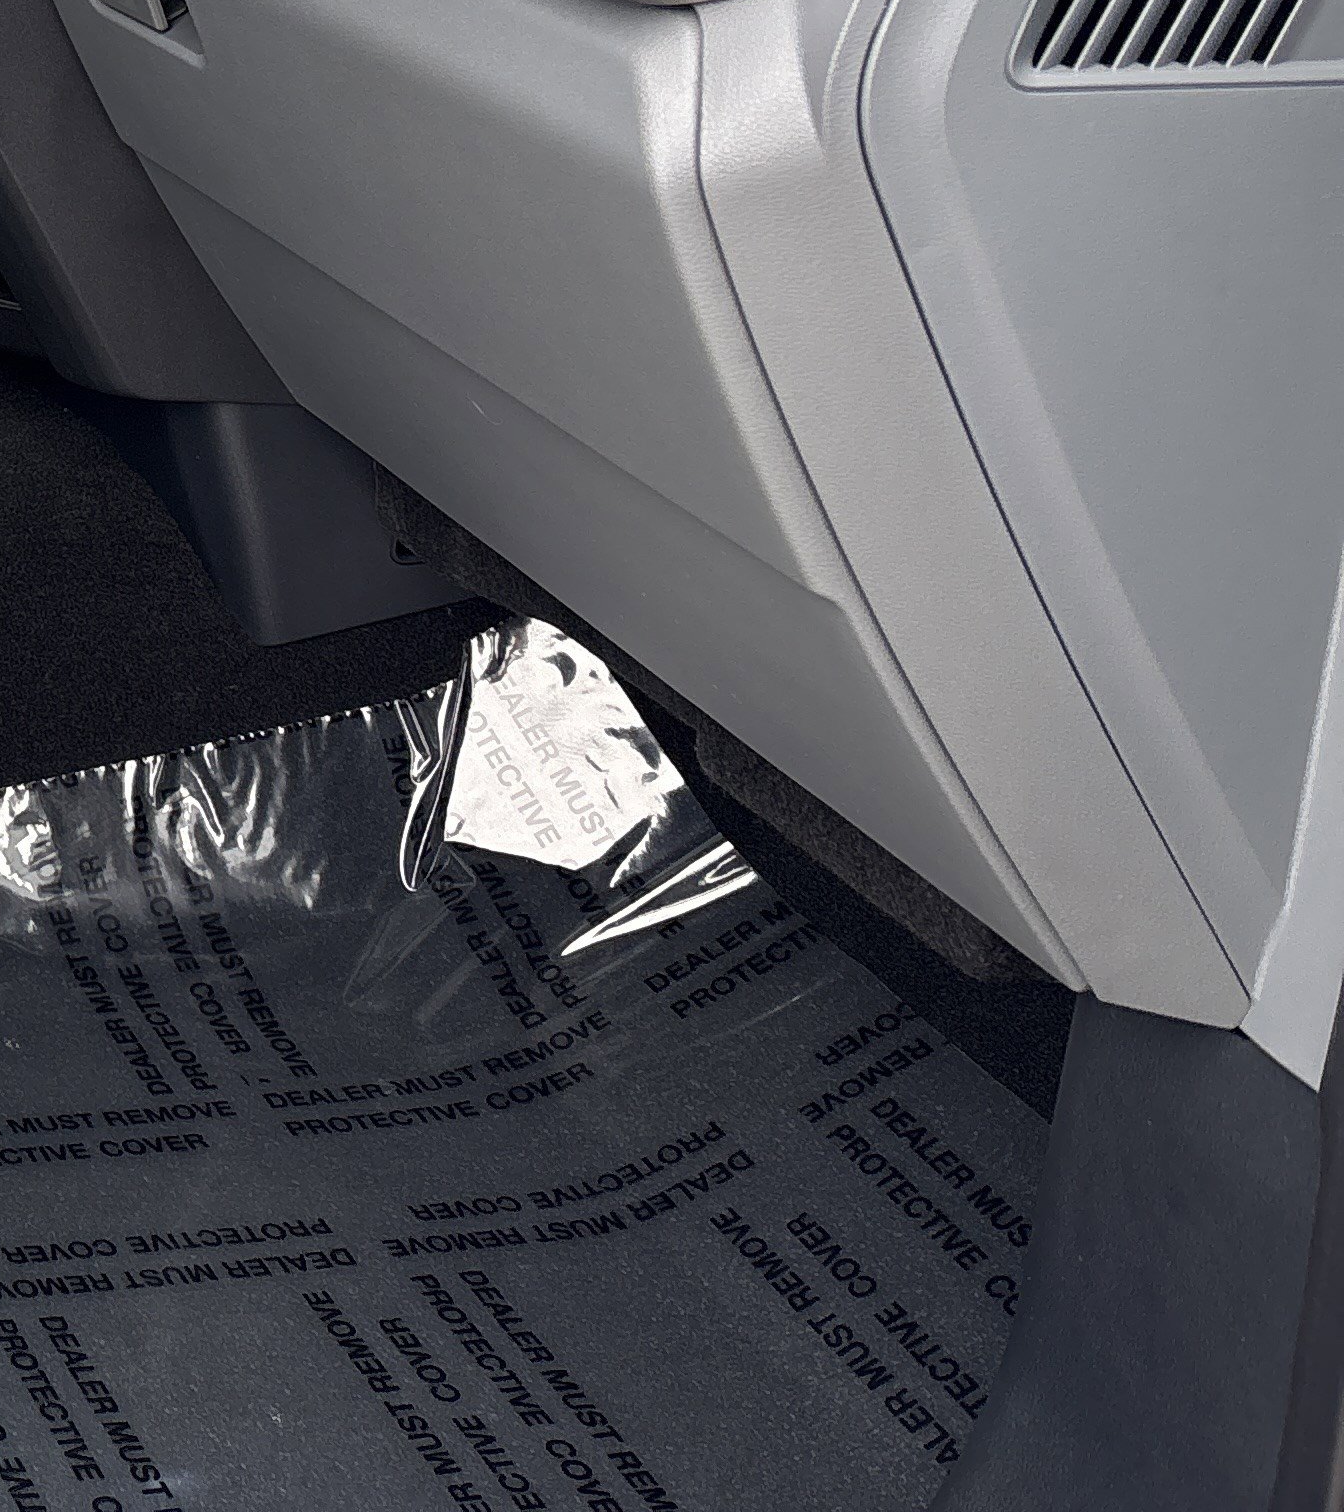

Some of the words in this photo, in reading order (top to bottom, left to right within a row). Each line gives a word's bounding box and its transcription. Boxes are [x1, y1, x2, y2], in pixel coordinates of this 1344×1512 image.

[549, 766, 616, 848] MUST
[472, 860, 588, 1009] PROTECTIVE
[643, 919, 762, 994] DEALER
[65, 954, 119, 1015] MUST
[188, 980, 252, 1057] COVER
[198, 912, 254, 983] MUST
[237, 988, 319, 1079] REMOVE
[467, 930, 547, 1029] DEALER
[104, 1012, 174, 1097] DEALER
[118, 963, 219, 1100] PROTECTIVE
[261, 1081, 388, 1110] DEALER
[389, 1064, 478, 1096] MUST
[480, 1008, 614, 1077] REMOVE
[7, 1112, 96, 1136] MUST
[101, 1099, 238, 1128] REMOVE
[282, 1099, 480, 1138] PROTECTIVE
[484, 1061, 596, 1112] COVER
[798, 1037, 935, 1124] REMOVE
[98, 1133, 211, 1159] COVER
[526, 1120, 727, 1211] PROTECTIVE
[870, 1096, 976, 1190] DEALER
[409, 1194, 523, 1223] COVER
[532, 1210, 629, 1244] MUST
[625, 1148, 756, 1223] DEALER
[826, 1123, 989, 1272] PROTECTIVE
[0, 1238, 117, 1266] COVER
[124, 1216, 333, 1255] PROTECTIVE
[124, 1262, 219, 1290] MUST
[222, 1246, 357, 1281] DEALER
[381, 1226, 528, 1259] REMOVE
[710, 1206, 820, 1315] REMOVE
[786, 1211, 877, 1299] COVER
[301, 1289, 400, 1396] REMOVE
[378, 1315, 462, 1404] COVER
[410, 1272, 554, 1428] PROTECTIVE
[457, 1268, 555, 1365] DEALER
[539, 1368, 625, 1445] MUST
[807, 1312, 895, 1391] MUST
[38, 1314, 120, 1415] DEALER
[101, 1421, 174, 1499] MUST
[384, 1398, 463, 1476] MUST
